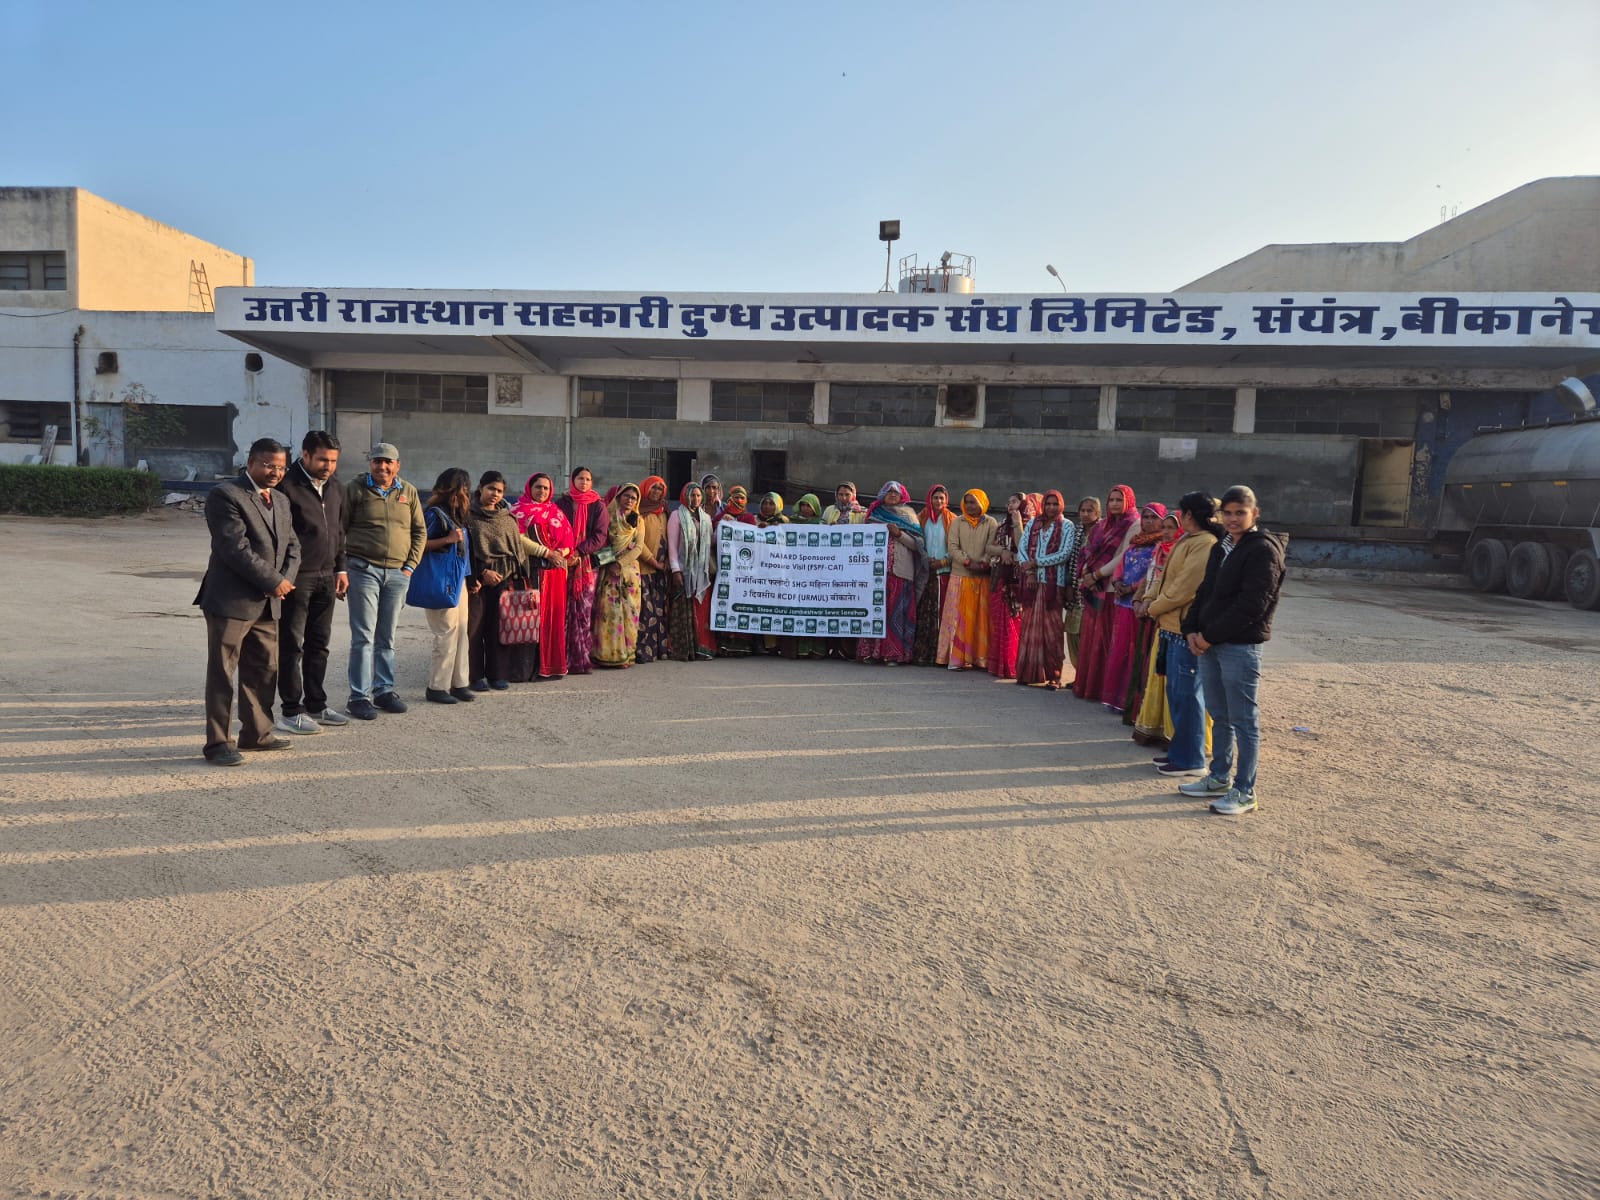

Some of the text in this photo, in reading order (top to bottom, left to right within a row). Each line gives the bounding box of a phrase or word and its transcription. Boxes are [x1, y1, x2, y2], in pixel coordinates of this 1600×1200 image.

[337, 299, 508, 325] राजस्थान
[513, 297, 673, 328] सहकारी
[678, 303, 765, 337] दुग्ध
[769, 305, 939, 332] उत्पादक
[944, 298, 1021, 332] संघ
